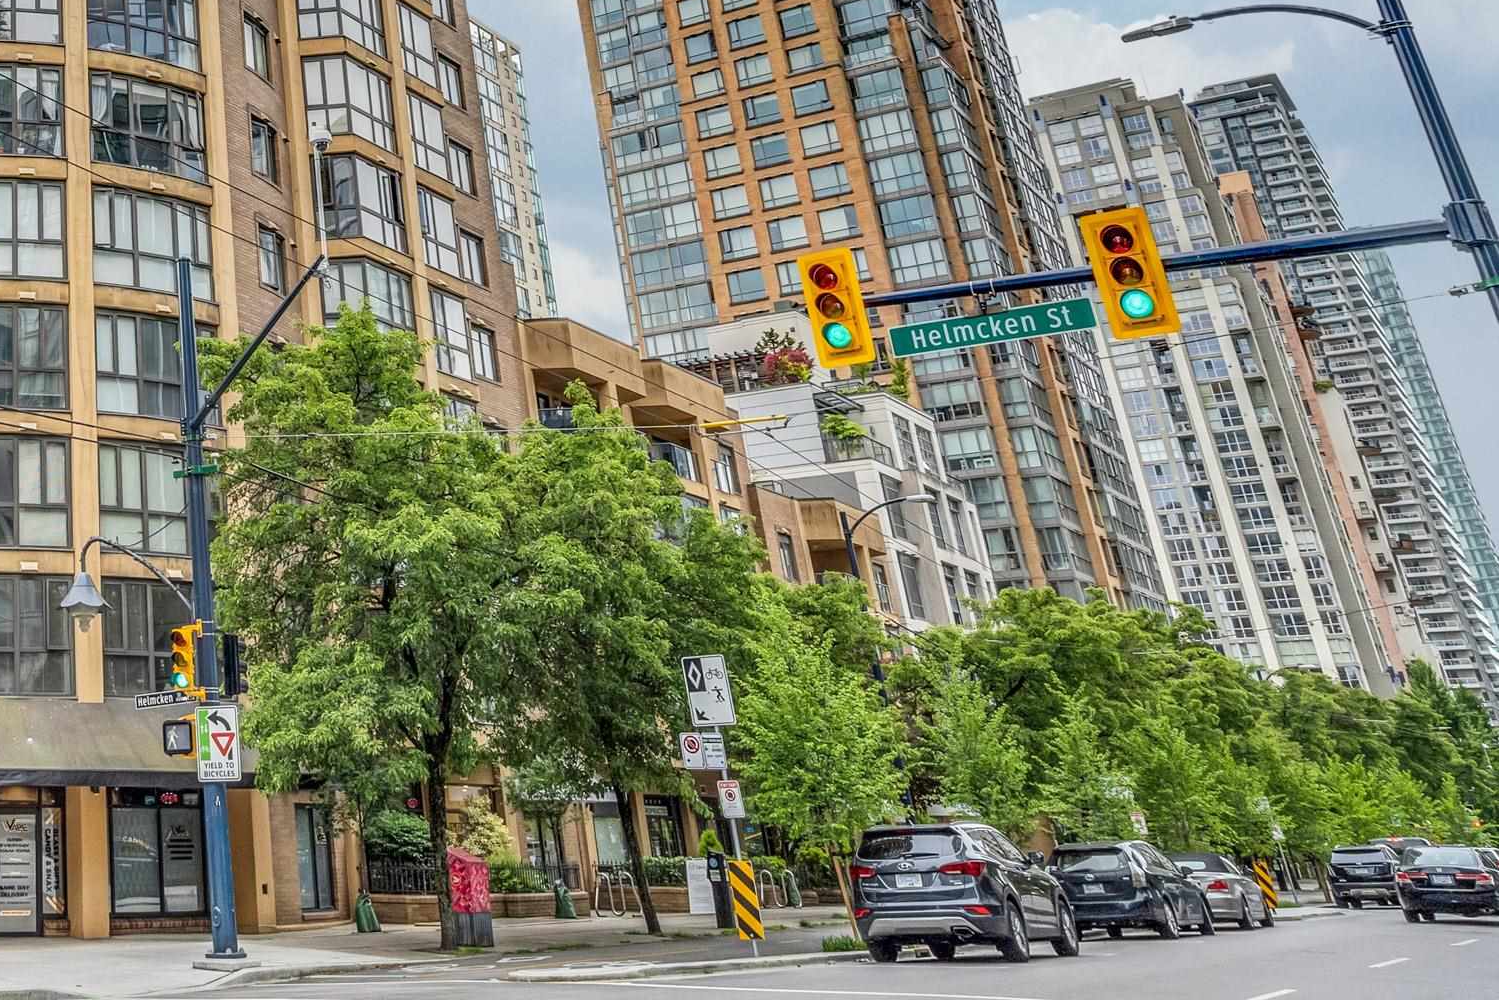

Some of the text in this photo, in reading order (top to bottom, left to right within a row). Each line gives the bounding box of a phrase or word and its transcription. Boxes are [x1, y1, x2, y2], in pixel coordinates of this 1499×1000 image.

[911, 305, 1074, 349] Helmcken St
[137, 694, 174, 707] Helmcken
[204, 761, 235, 769] YIELD TO
[203, 770, 236, 778] BICYCLES
